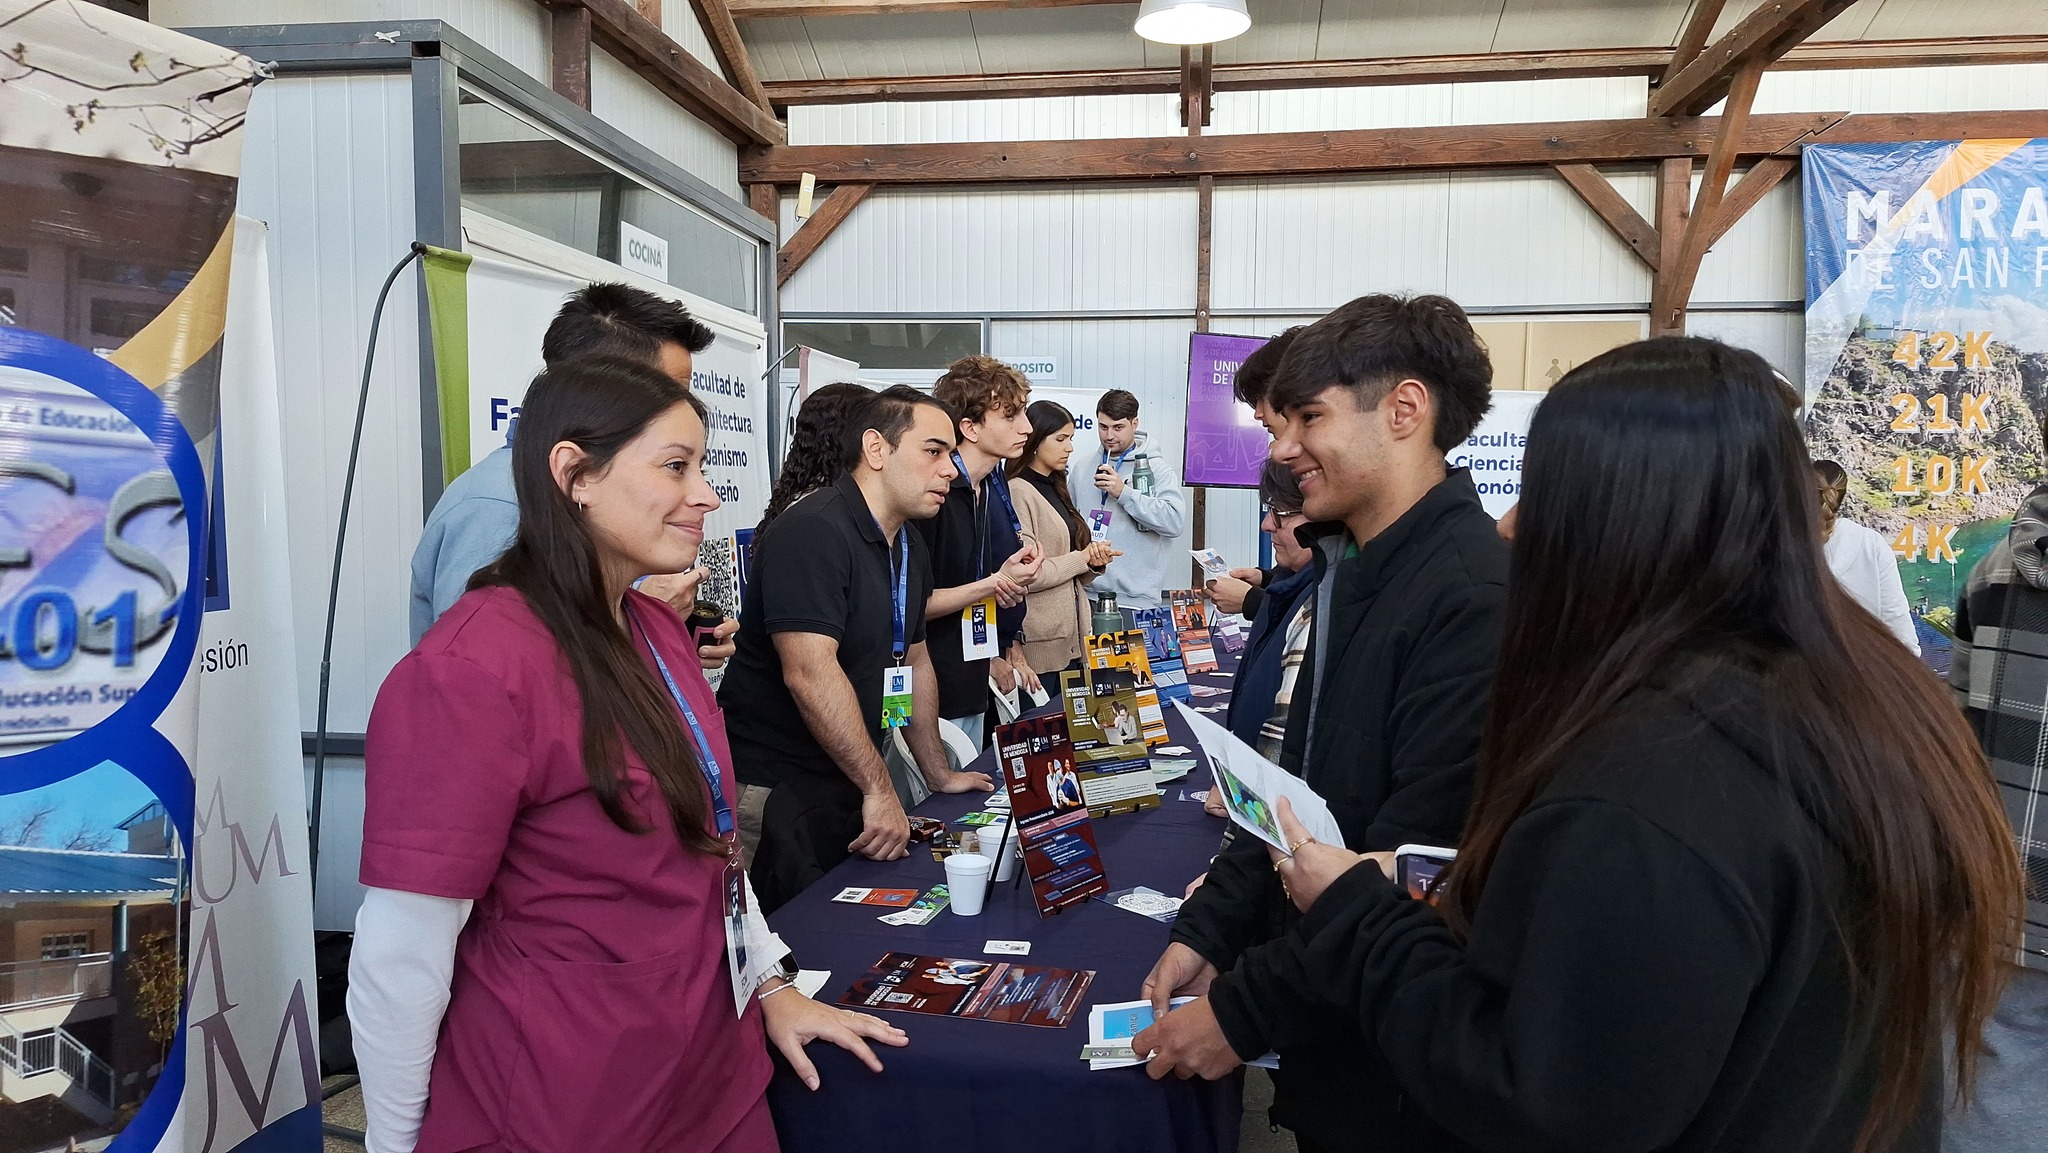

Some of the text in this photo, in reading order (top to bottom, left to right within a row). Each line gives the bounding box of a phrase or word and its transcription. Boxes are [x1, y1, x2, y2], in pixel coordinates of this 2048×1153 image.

[629, 239, 662, 269] COCINA
[1846, 249, 1895, 291] DE
[1921, 247, 2009, 290] SAN
[1892, 331, 1995, 372] 42K
[1008, 362, 1054, 374] POSITO
[1214, 360, 1243, 373] UNIV
[691, 370, 746, 399] acultad de
[1213, 373, 1229, 385] DE
[706, 405, 754, 436] uitectura,
[1075, 414, 1093, 430] de
[1890, 393, 1995, 434] 21K
[1467, 431, 1527, 448] aculta
[705, 444, 748, 468] banismo
[1455, 454, 1523, 472] Ciencia
[1891, 455, 1995, 497] 10K
[704, 478, 740, 503] iseño
[1891, 523, 1960, 564] 4K
[98, 684, 137, 703] Sup
[893, 677, 903, 687] UM
